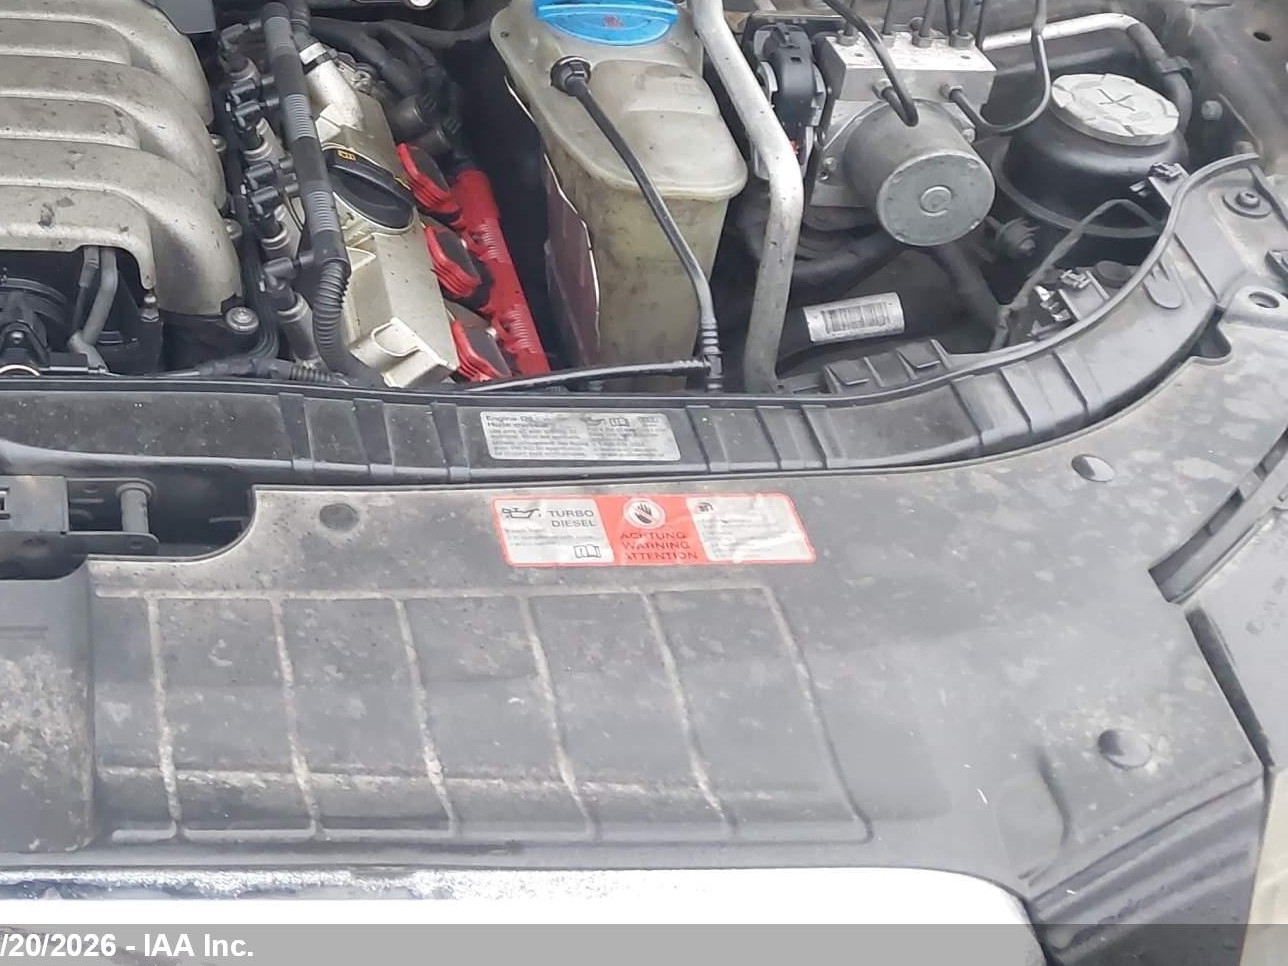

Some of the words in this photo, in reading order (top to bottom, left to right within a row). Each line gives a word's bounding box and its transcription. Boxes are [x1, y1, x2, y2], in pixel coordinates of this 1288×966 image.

[547, 509, 594, 518] TURBO
[551, 519, 597, 528] DIESEL
[620, 531, 688, 540] ACHTUNG
[622, 541, 691, 550] WARNING
[625, 551, 699, 561] ATTENTION
